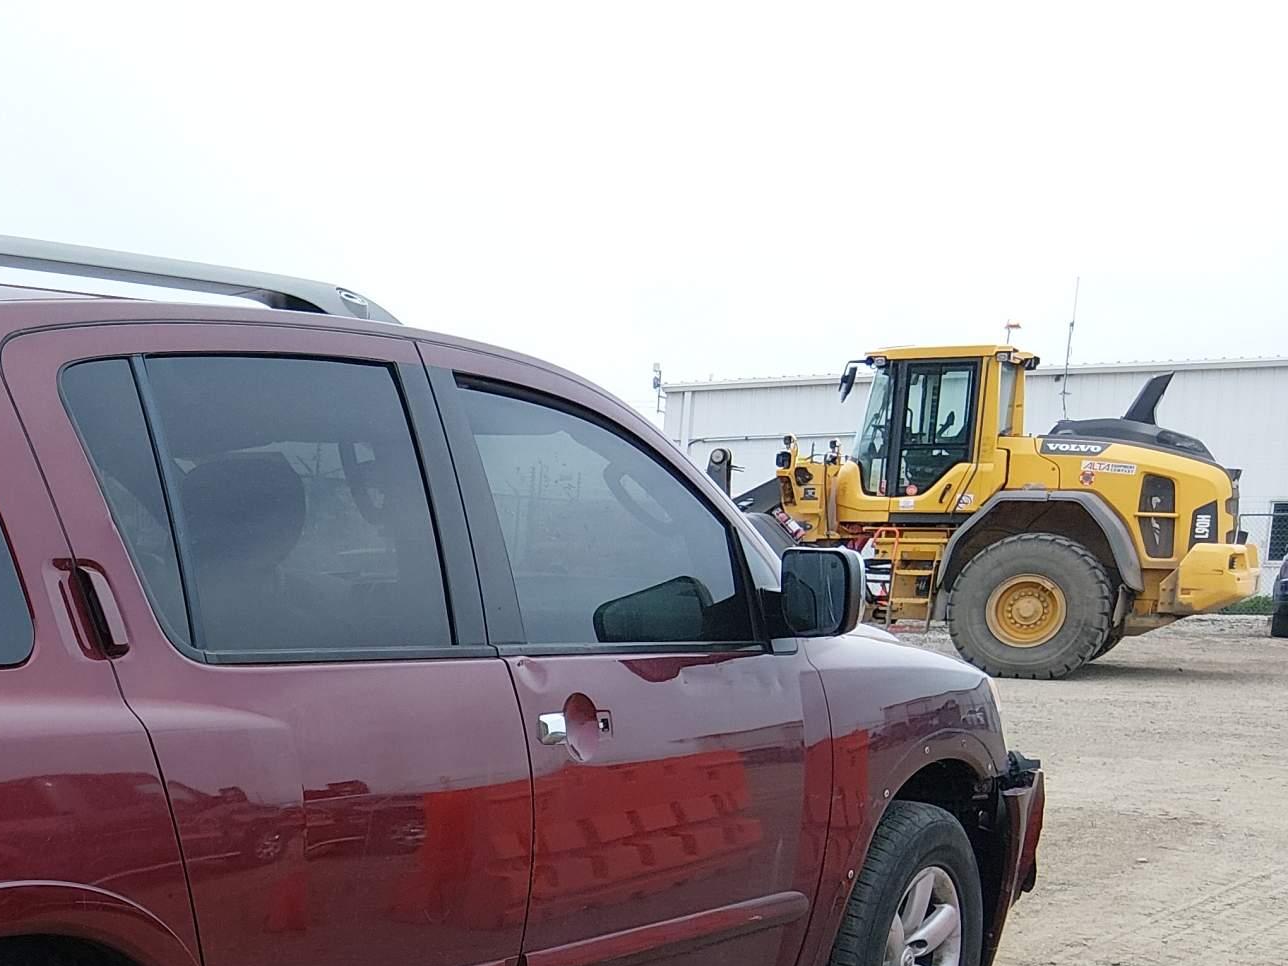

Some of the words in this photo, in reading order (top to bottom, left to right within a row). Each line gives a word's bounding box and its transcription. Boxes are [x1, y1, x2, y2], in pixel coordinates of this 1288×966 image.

[1047, 443, 1102, 453] VOLVO
[1083, 461, 1111, 471] ALTA
[1194, 514, 1212, 539] L90H
